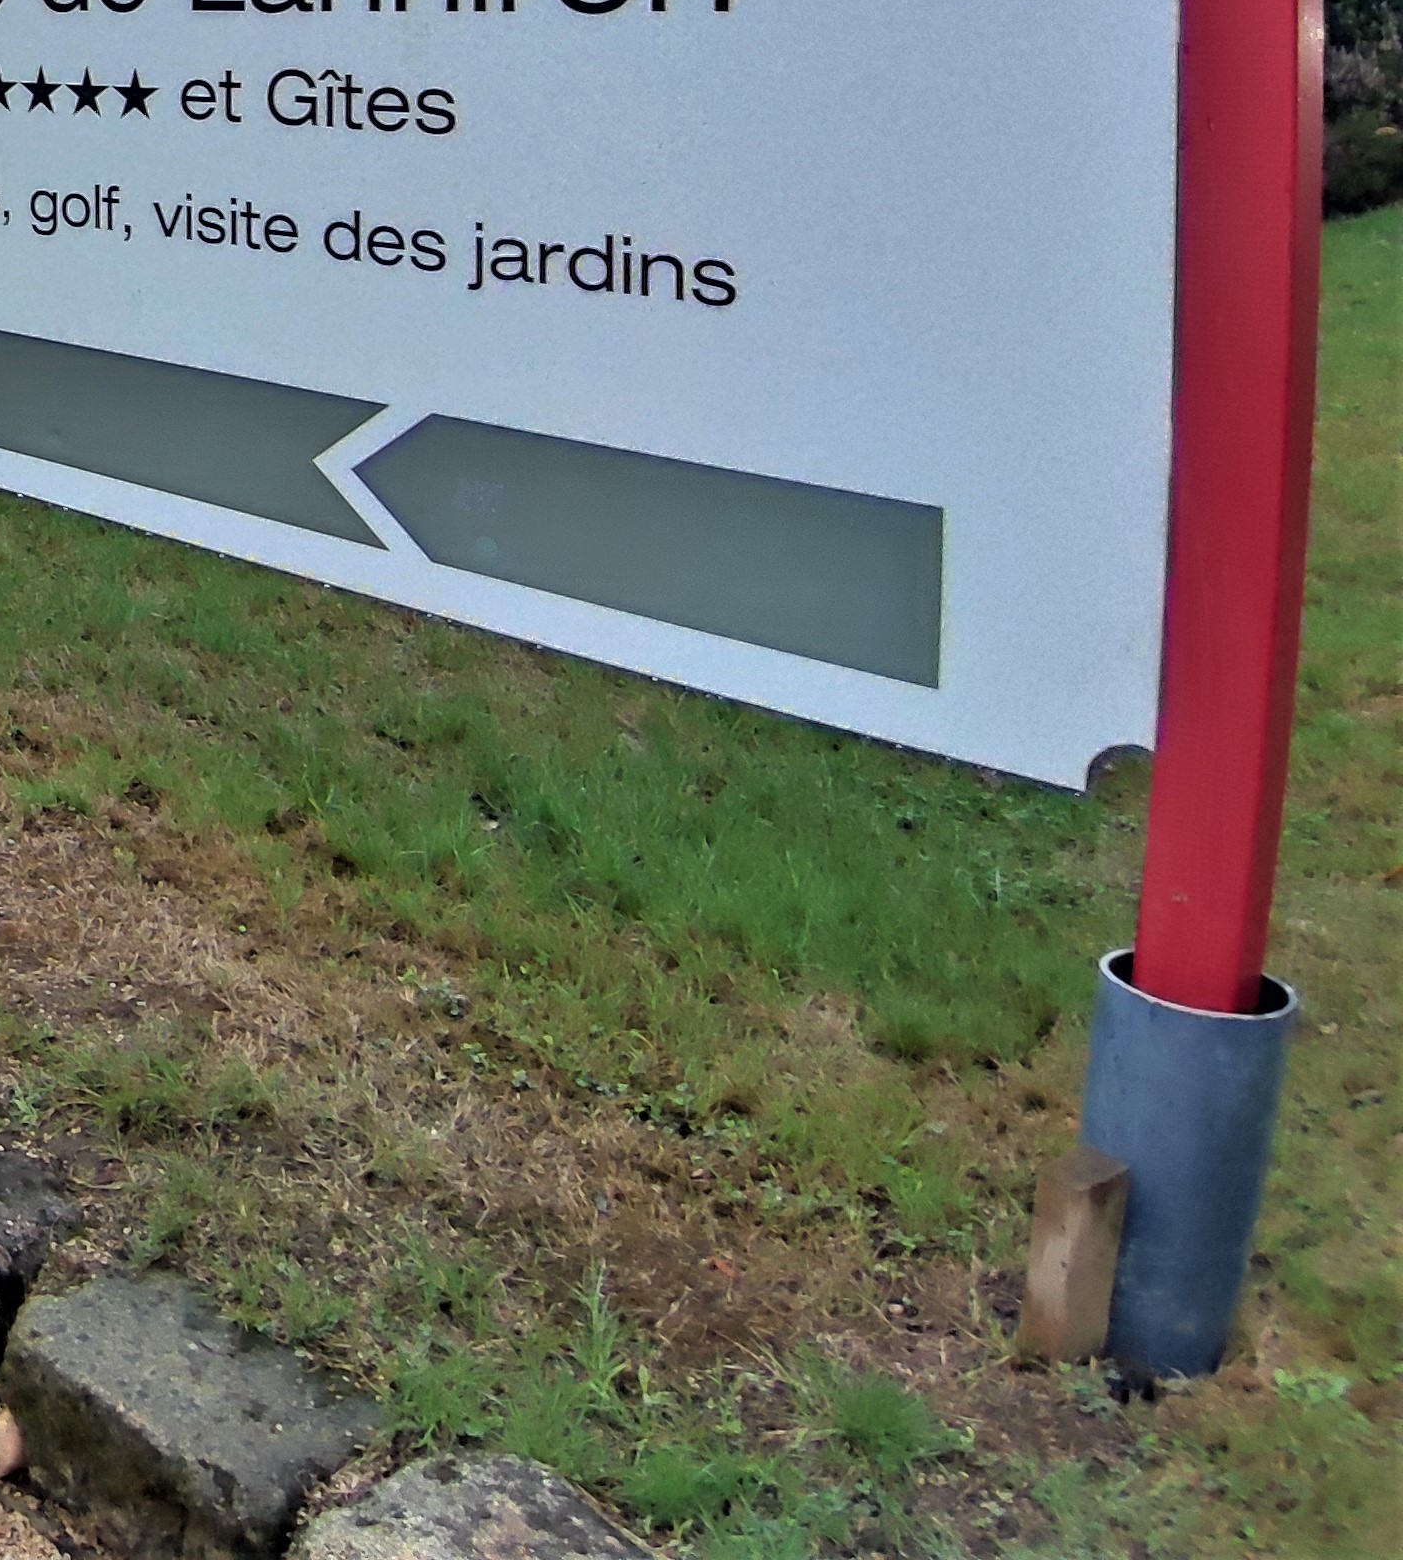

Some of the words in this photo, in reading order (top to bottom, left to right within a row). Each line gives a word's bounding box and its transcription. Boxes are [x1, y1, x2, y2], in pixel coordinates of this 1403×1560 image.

[179, 69, 243, 124] et
[266, 67, 457, 136] Gîtes
[29, 183, 133, 243] golf,
[151, 192, 300, 254] visite
[322, 209, 447, 273] des
[464, 220, 738, 308] jardins
